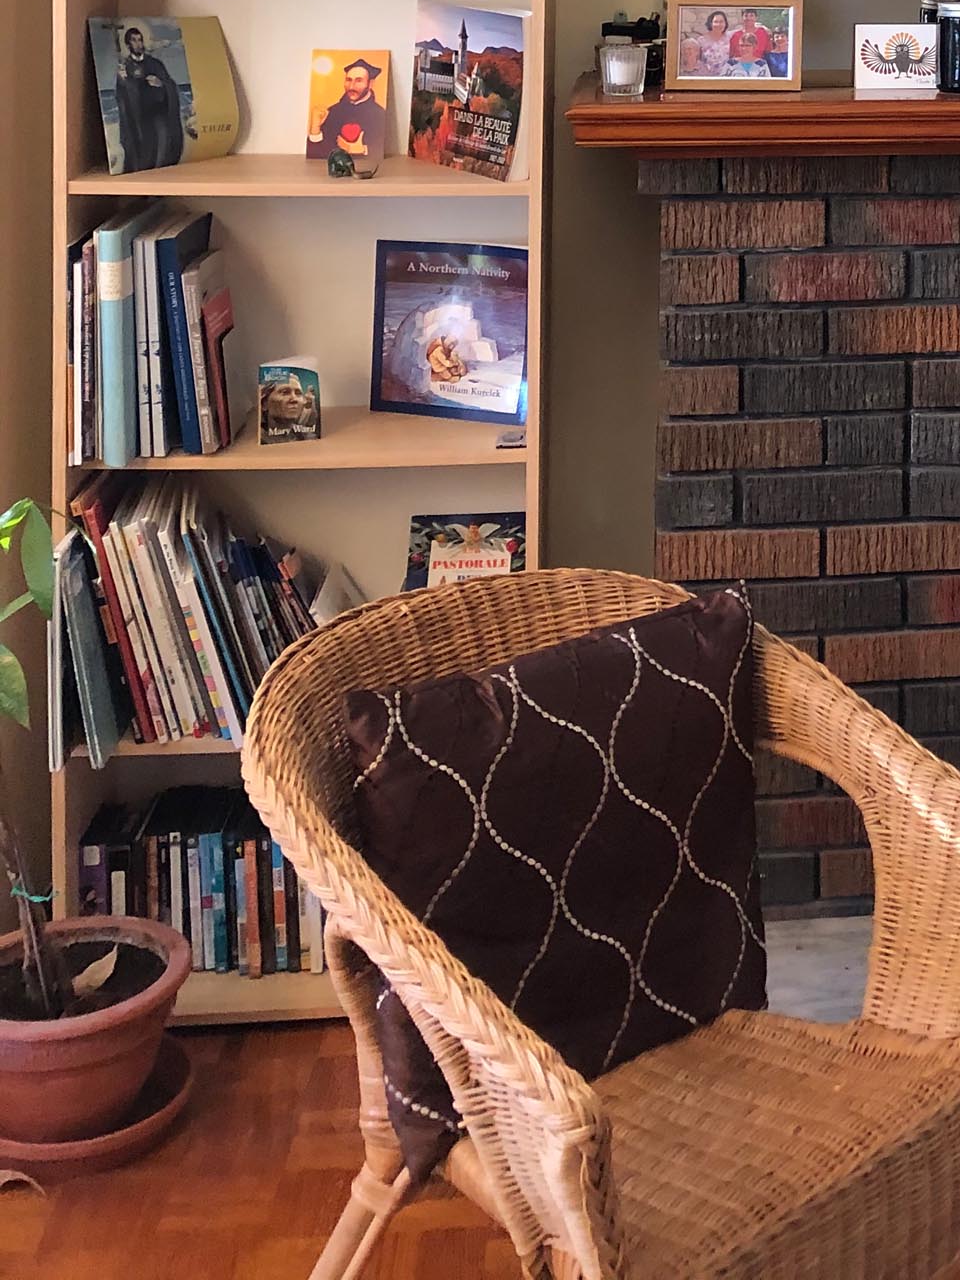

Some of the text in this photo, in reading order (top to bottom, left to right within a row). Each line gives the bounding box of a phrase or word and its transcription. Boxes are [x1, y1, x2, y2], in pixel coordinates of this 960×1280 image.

[454, 109, 474, 124] DANS
[474, 114, 484, 127] LA
[472, 126, 483, 139] DE
[483, 129, 494, 142] LA
[494, 131, 510, 145] PAIX
[407, 261, 511, 281] A Northern Nativity
[439, 383, 469, 395] William
[268, 424, 316, 437] Mary Ward
[432, 558, 509, 570] PASTORALE
